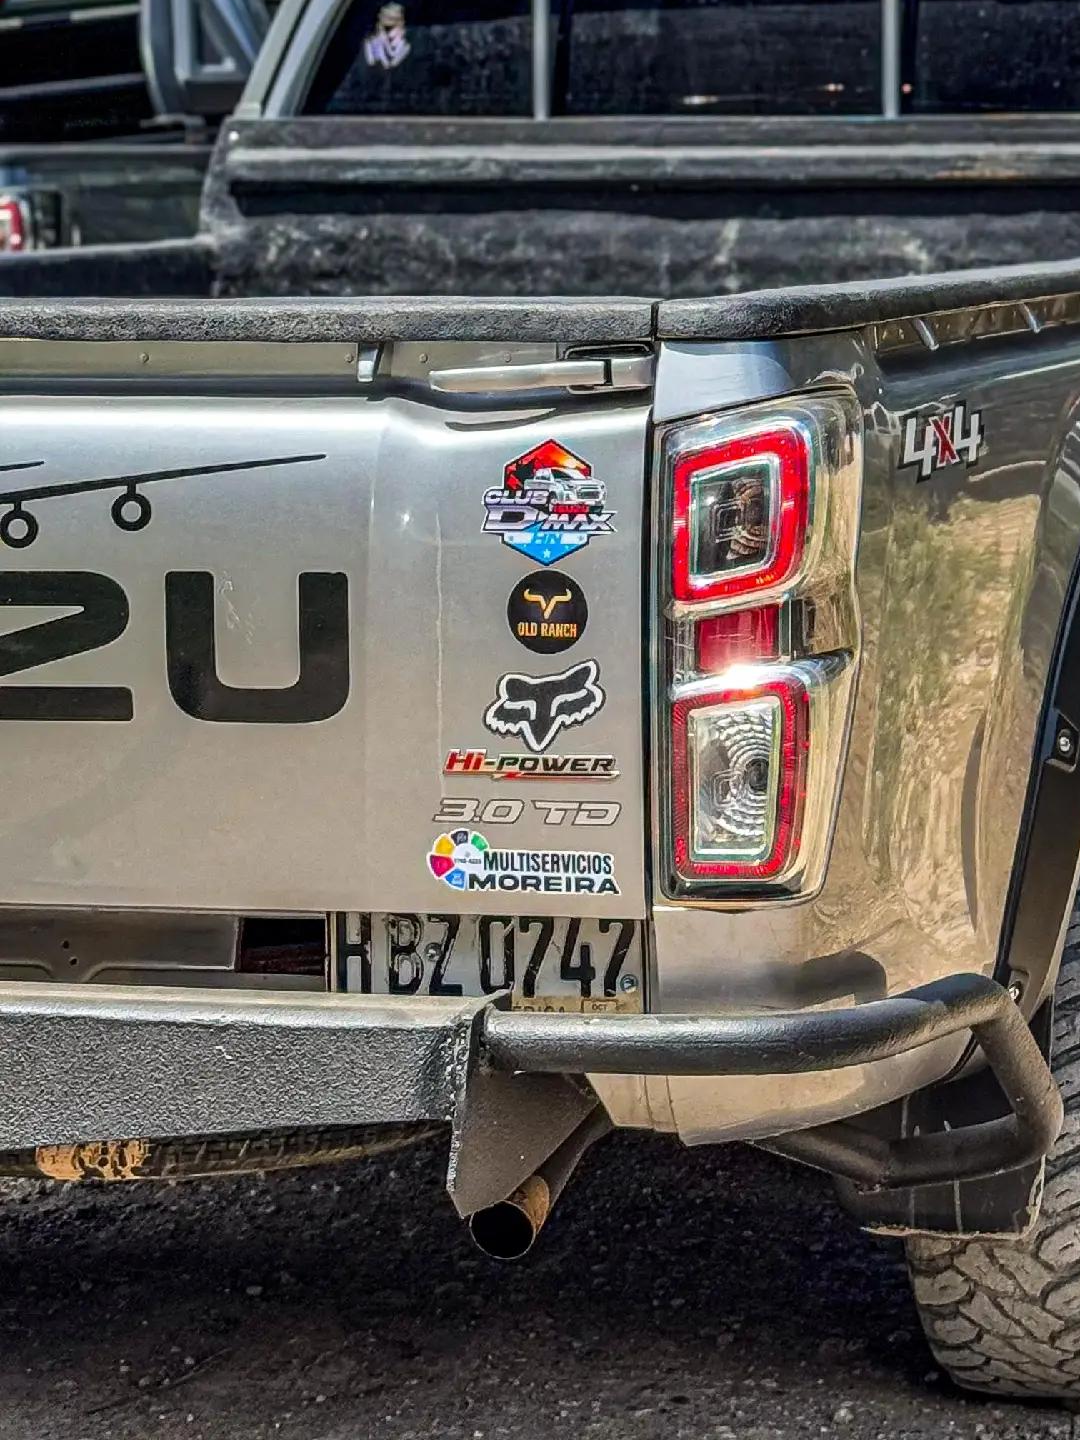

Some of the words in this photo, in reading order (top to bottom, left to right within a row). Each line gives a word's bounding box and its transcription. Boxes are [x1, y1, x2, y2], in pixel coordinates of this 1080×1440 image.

[485, 490, 549, 504] CLUB
[517, 621, 538, 637] OLD
[540, 622, 577, 638] RANCH
[433, 798, 525, 824] 3.0
[531, 800, 622, 826] TD
[483, 851, 612, 874] MULTISERVICIOS
[468, 873, 620, 894] MOREIRA
